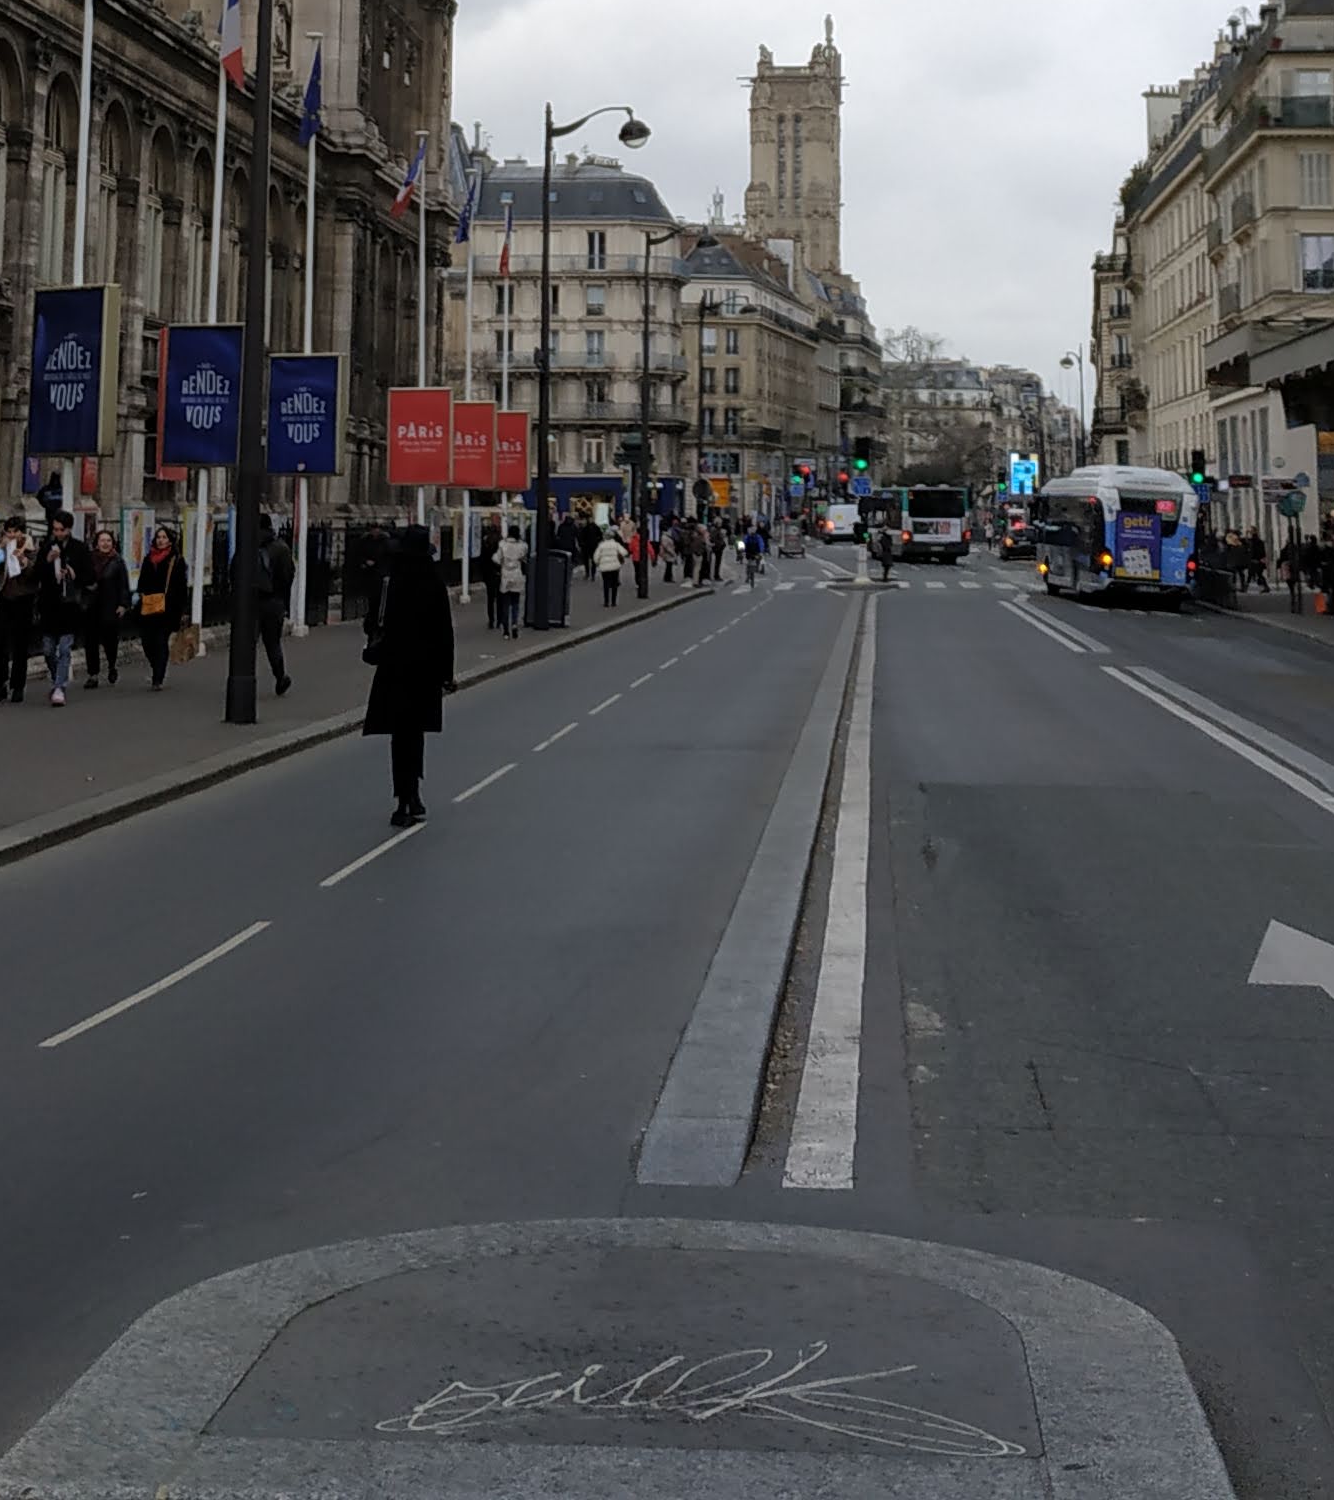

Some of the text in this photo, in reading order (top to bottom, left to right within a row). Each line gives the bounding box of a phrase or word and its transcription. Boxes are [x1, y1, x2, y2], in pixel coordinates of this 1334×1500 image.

[181, 369, 230, 395] RENDEZ
[50, 382, 85, 412] VOUS
[280, 392, 327, 415] RENDEZ
[185, 405, 223, 429] VOUS
[287, 423, 320, 444] VOUS
